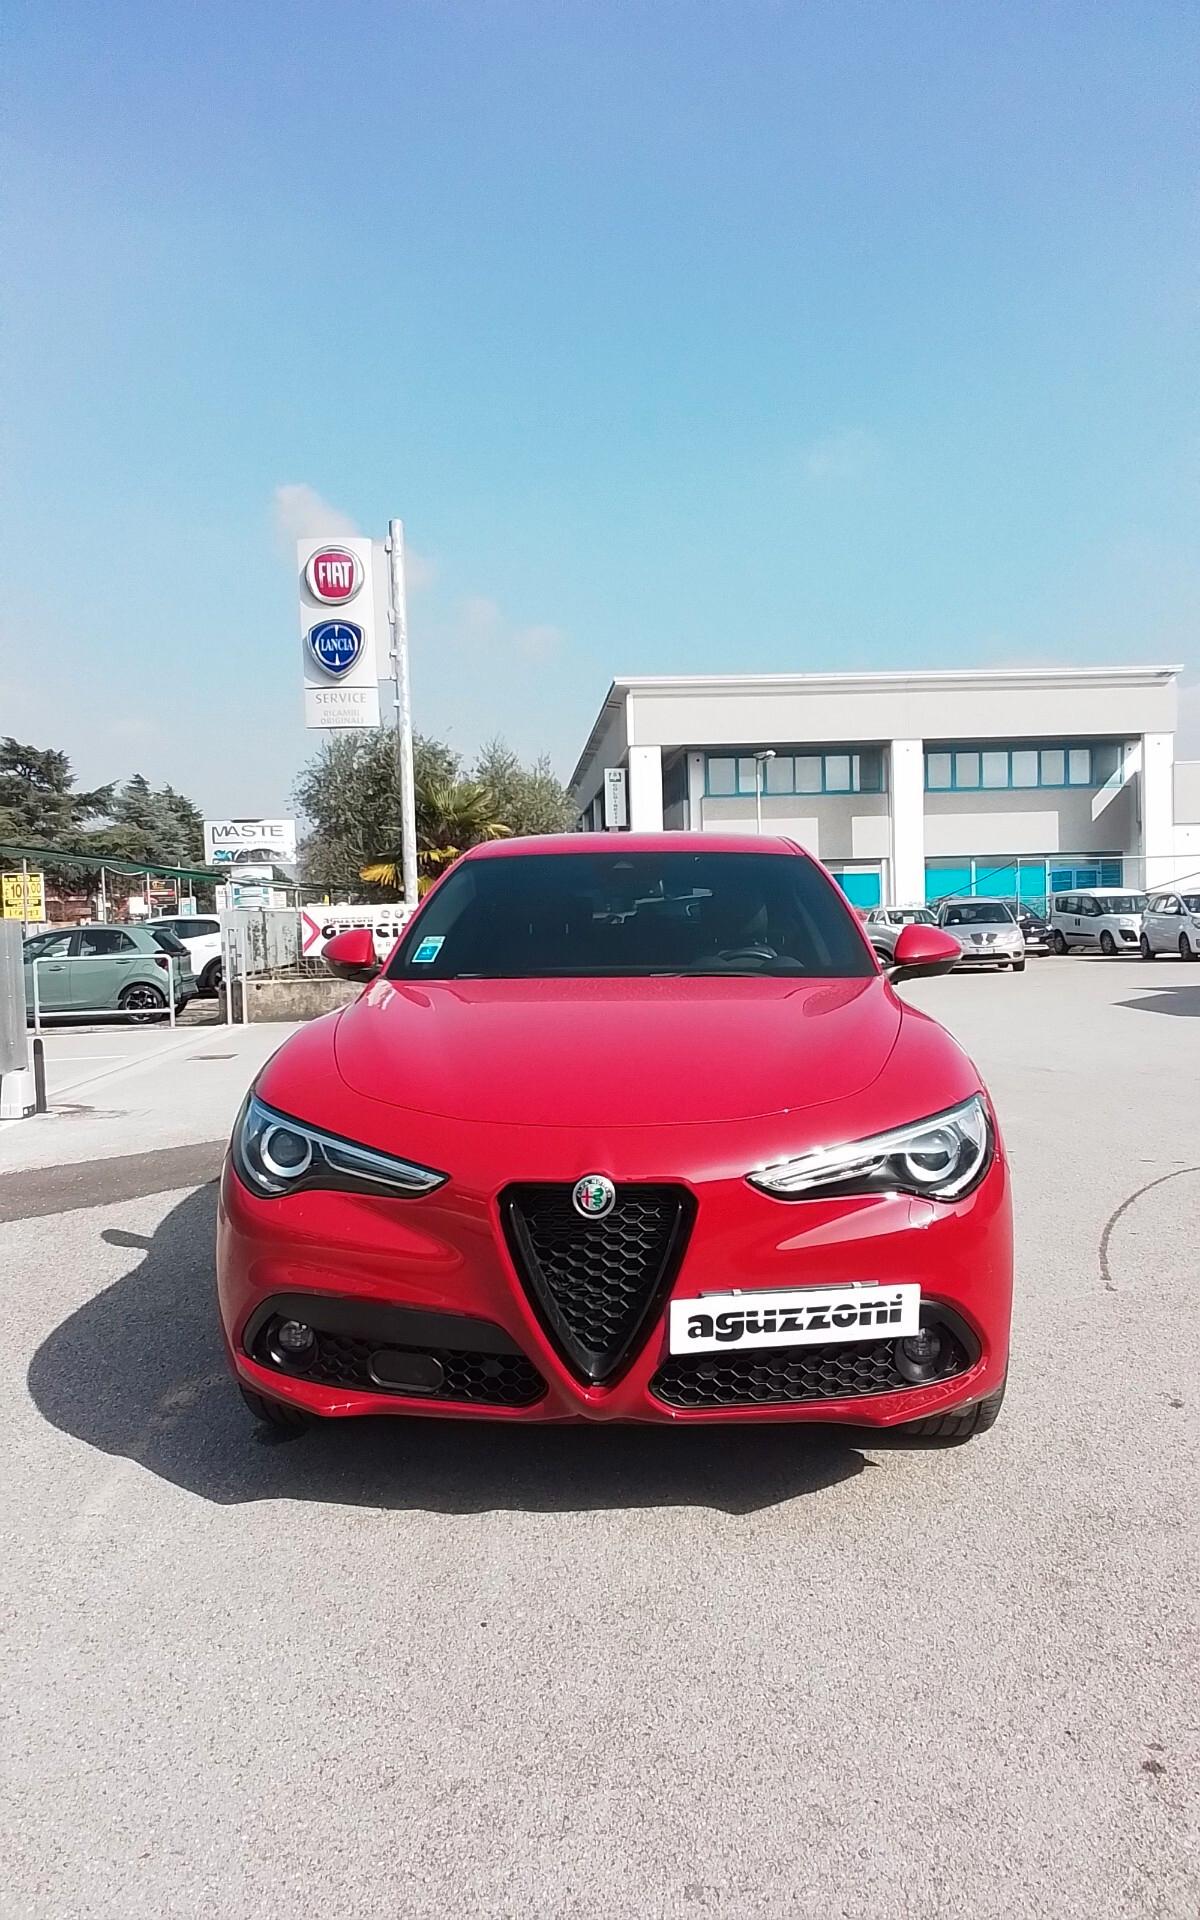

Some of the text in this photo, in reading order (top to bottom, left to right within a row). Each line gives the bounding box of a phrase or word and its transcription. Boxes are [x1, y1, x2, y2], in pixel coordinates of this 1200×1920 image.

[318, 561, 352, 588] FIAT
[321, 639, 354, 651] LANCIA
[315, 693, 367, 704] SERVICE
[687, 1293, 903, 1342] aguzzoni
